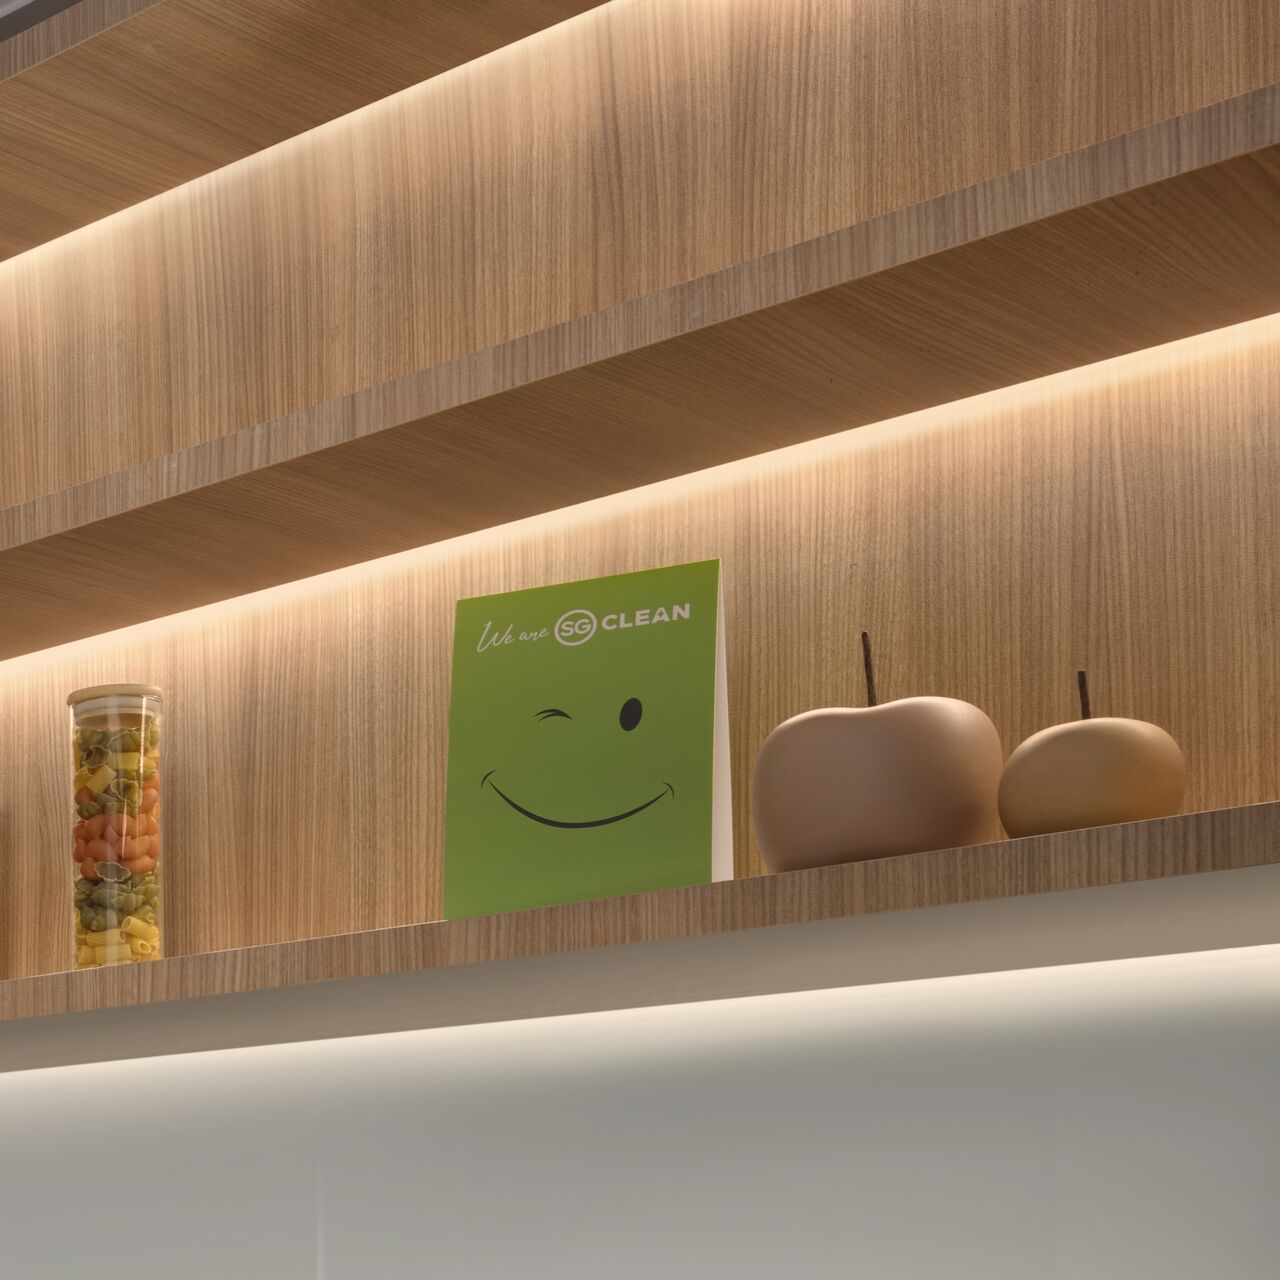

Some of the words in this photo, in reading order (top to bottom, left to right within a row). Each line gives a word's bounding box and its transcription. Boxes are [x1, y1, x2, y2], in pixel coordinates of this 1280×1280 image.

[476, 621, 515, 653] We
[518, 627, 550, 642] are
[560, 618, 592, 637] SG
[600, 603, 691, 631] CLEAN
